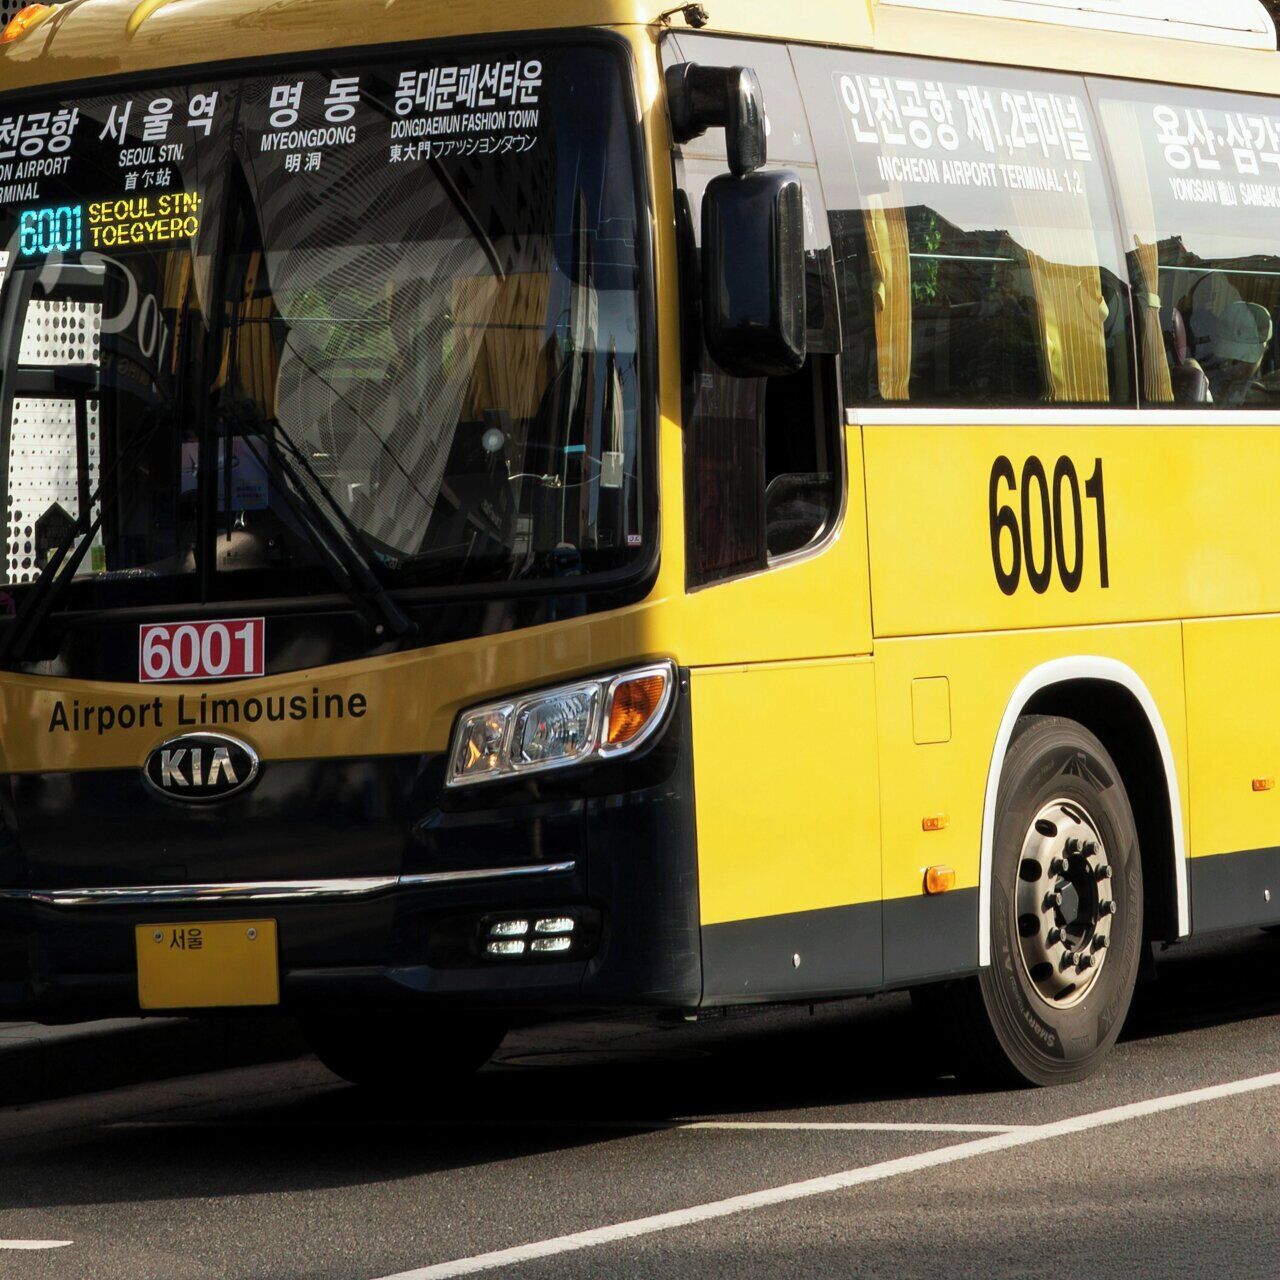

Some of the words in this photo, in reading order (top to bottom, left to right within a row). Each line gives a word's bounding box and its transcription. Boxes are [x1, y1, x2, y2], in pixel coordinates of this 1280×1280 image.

[394, 60, 543, 115] 동대문패션타운
[260, 125, 357, 152] MYEONGDONG
[390, 115, 460, 139] DONGDAEMUN
[461, 111, 506, 132] FASHION
[508, 109, 539, 129] TOWN
[839, 74, 959, 151] 인천공항
[956, 84, 1093, 162] 제1,2터미널
[15, 156, 71, 179] AIRPORT
[118, 146, 157, 167] SEOUL
[158, 143, 184, 163] STN.
[876, 155, 941, 184] INCHEON
[941, 159, 998, 187] AIRPORT
[998, 162, 1063, 192] TERMINAL
[1063, 169, 1083, 196] 1,2
[1169, 177, 1218, 203] YONGSAN
[20, 204, 82, 257] 6001
[89, 197, 157, 224] SEOUL
[89, 216, 199, 247] TOEGYERO
[988, 454, 1110, 597] 6001
[142, 621, 255, 679] 6001
[48, 696, 164, 735] Airport
[177, 687, 368, 726] Limousine
[160, 747, 239, 788] KIA
[169, 928, 203, 950] 서울
